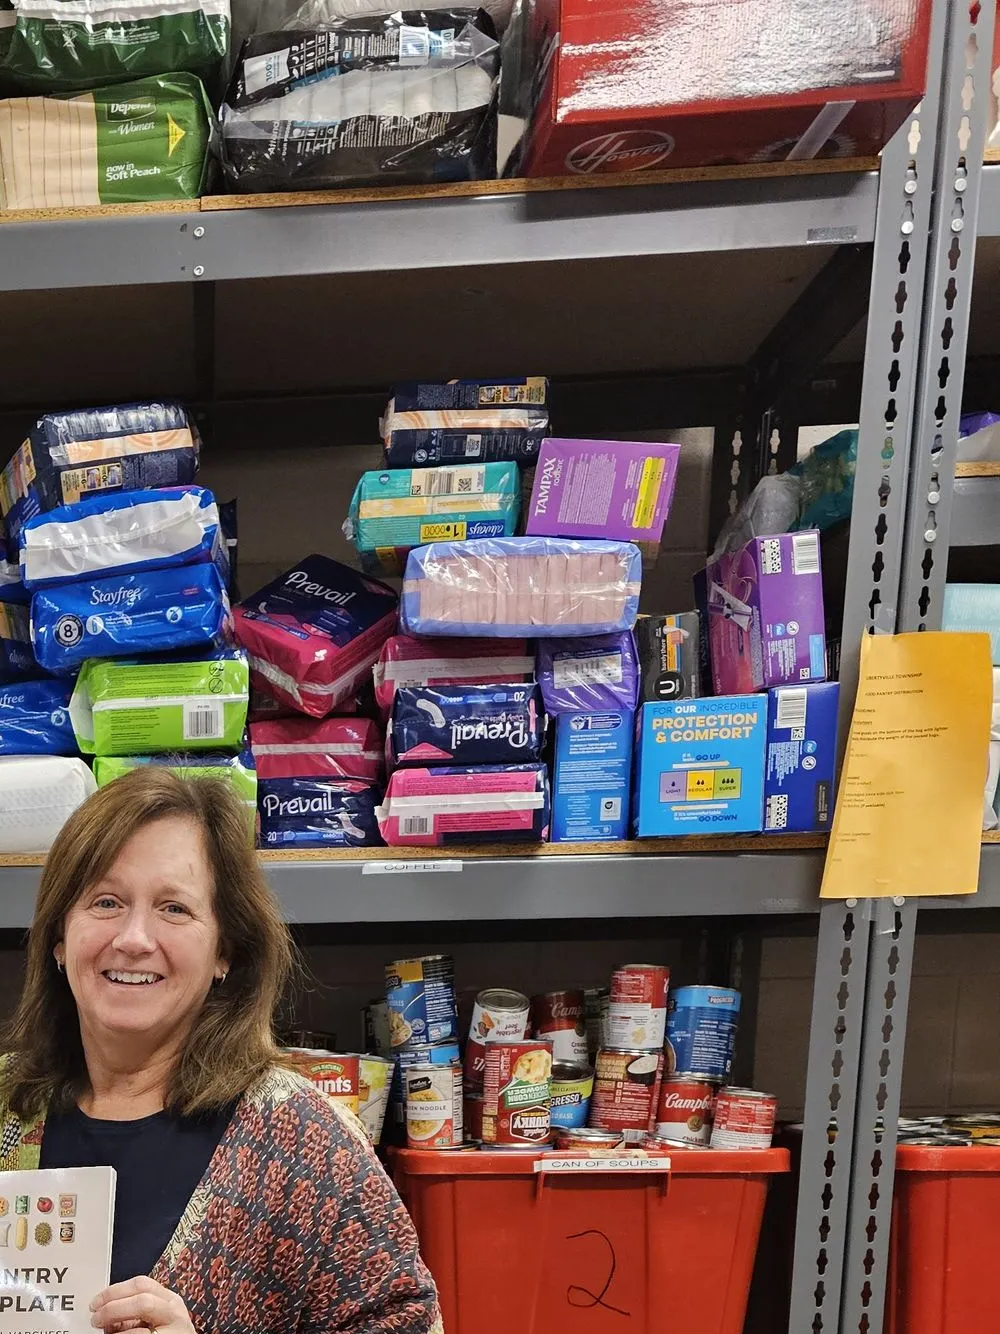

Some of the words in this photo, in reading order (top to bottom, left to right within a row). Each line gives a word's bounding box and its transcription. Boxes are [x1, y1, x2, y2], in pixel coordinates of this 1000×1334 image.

[106, 171, 128, 182] Soft
[130, 166, 161, 178] Peach
[534, 457, 557, 518] TAMPAX
[90, 587, 142, 606] Stayfree
[285, 570, 357, 607] Prevail
[513, 691, 525, 702] 20
[652, 706, 673, 715] FOR
[675, 705, 697, 714] OUR
[699, 701, 759, 713] INCREDIBLE
[652, 712, 758, 730] PROTECTION
[451, 720, 529, 750] Prevail
[655, 732, 667, 744] &
[670, 726, 753, 742] COMFORT
[262, 791, 334, 817] Prevail
[712, 814, 738, 822] DOWN
[267, 831, 277, 841] 20
[384, 863, 441, 871] COFFEE
[550, 1094, 580, 1106] GRESSO
[551, 1159, 581, 1168] CAN
[585, 1159, 606, 1168] OF
[609, 1158, 659, 1167] SOUPS
[566, 1229, 631, 1316] 2
[0, 1295, 75, 1313] PLATE
